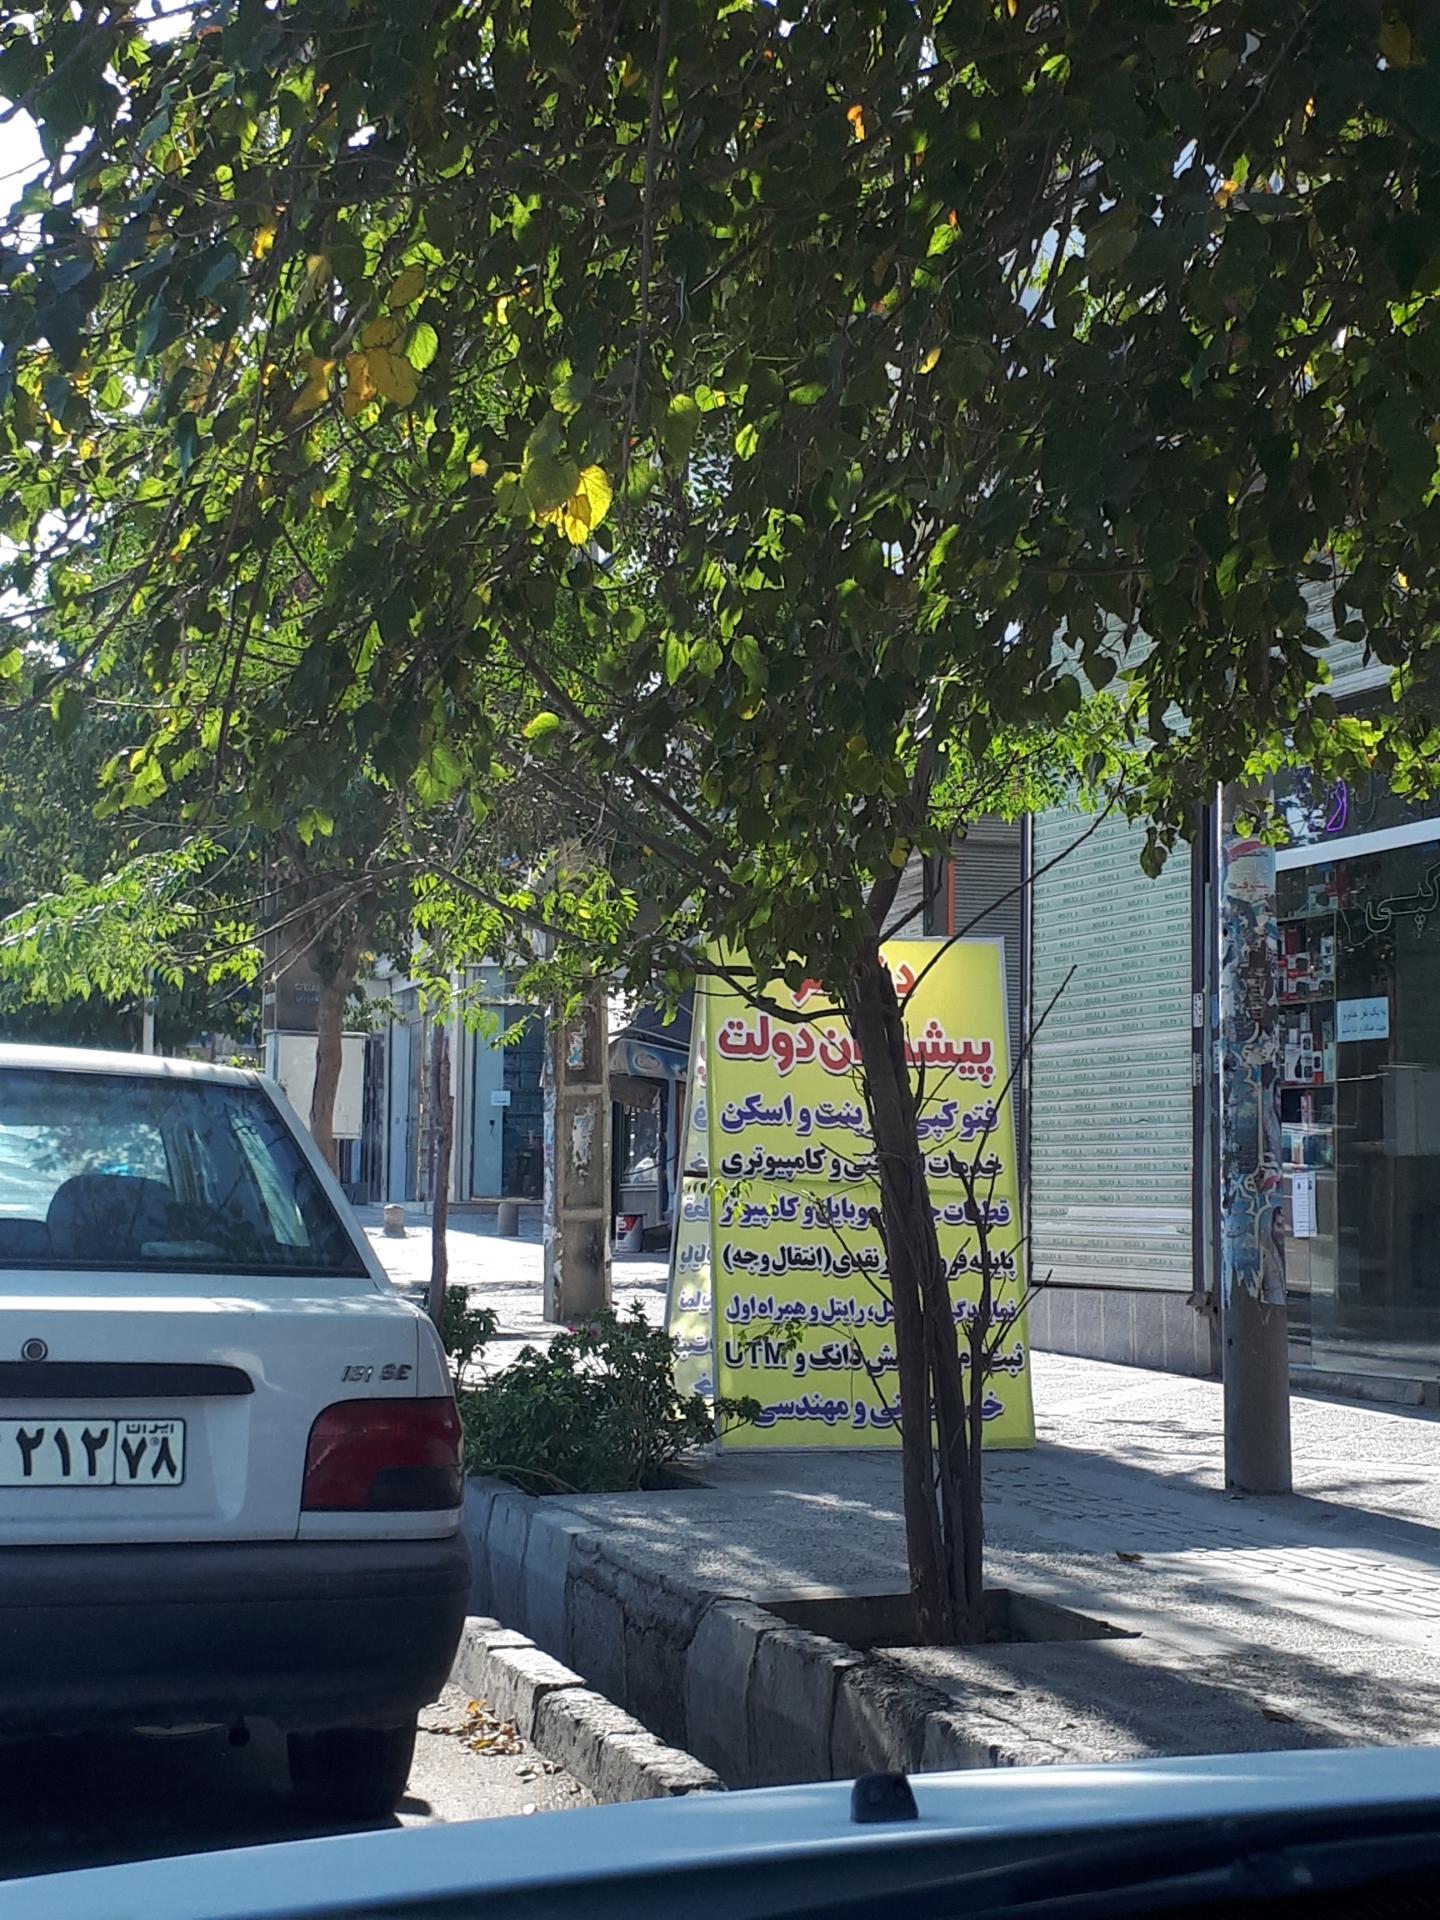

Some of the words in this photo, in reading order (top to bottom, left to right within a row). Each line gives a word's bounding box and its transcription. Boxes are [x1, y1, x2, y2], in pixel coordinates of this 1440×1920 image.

[719, 1015, 815, 1071] دولت
[720, 1093, 793, 1131] اسکن
[796, 1107, 812, 1133] و
[720, 1146, 826, 1177] کامپیوتری
[828, 1157, 842, 1179] و
[802, 1205, 814, 1226] و
[726, 1295, 756, 1320] اول
[757, 1296, 806, 1321] همراه
[809, 1303, 819, 1321] و
[821, 1297, 864, 1325] رایتل
[725, 1339, 788, 1365] UTM
[792, 1352, 805, 1373] و
[380, 1363, 412, 1381] SE
[753, 1392, 849, 1423] مهندسی
[852, 1400, 867, 1425] و
[125, 1422, 174, 1435] ایران
[120, 1436, 178, 1480] ۷۸
